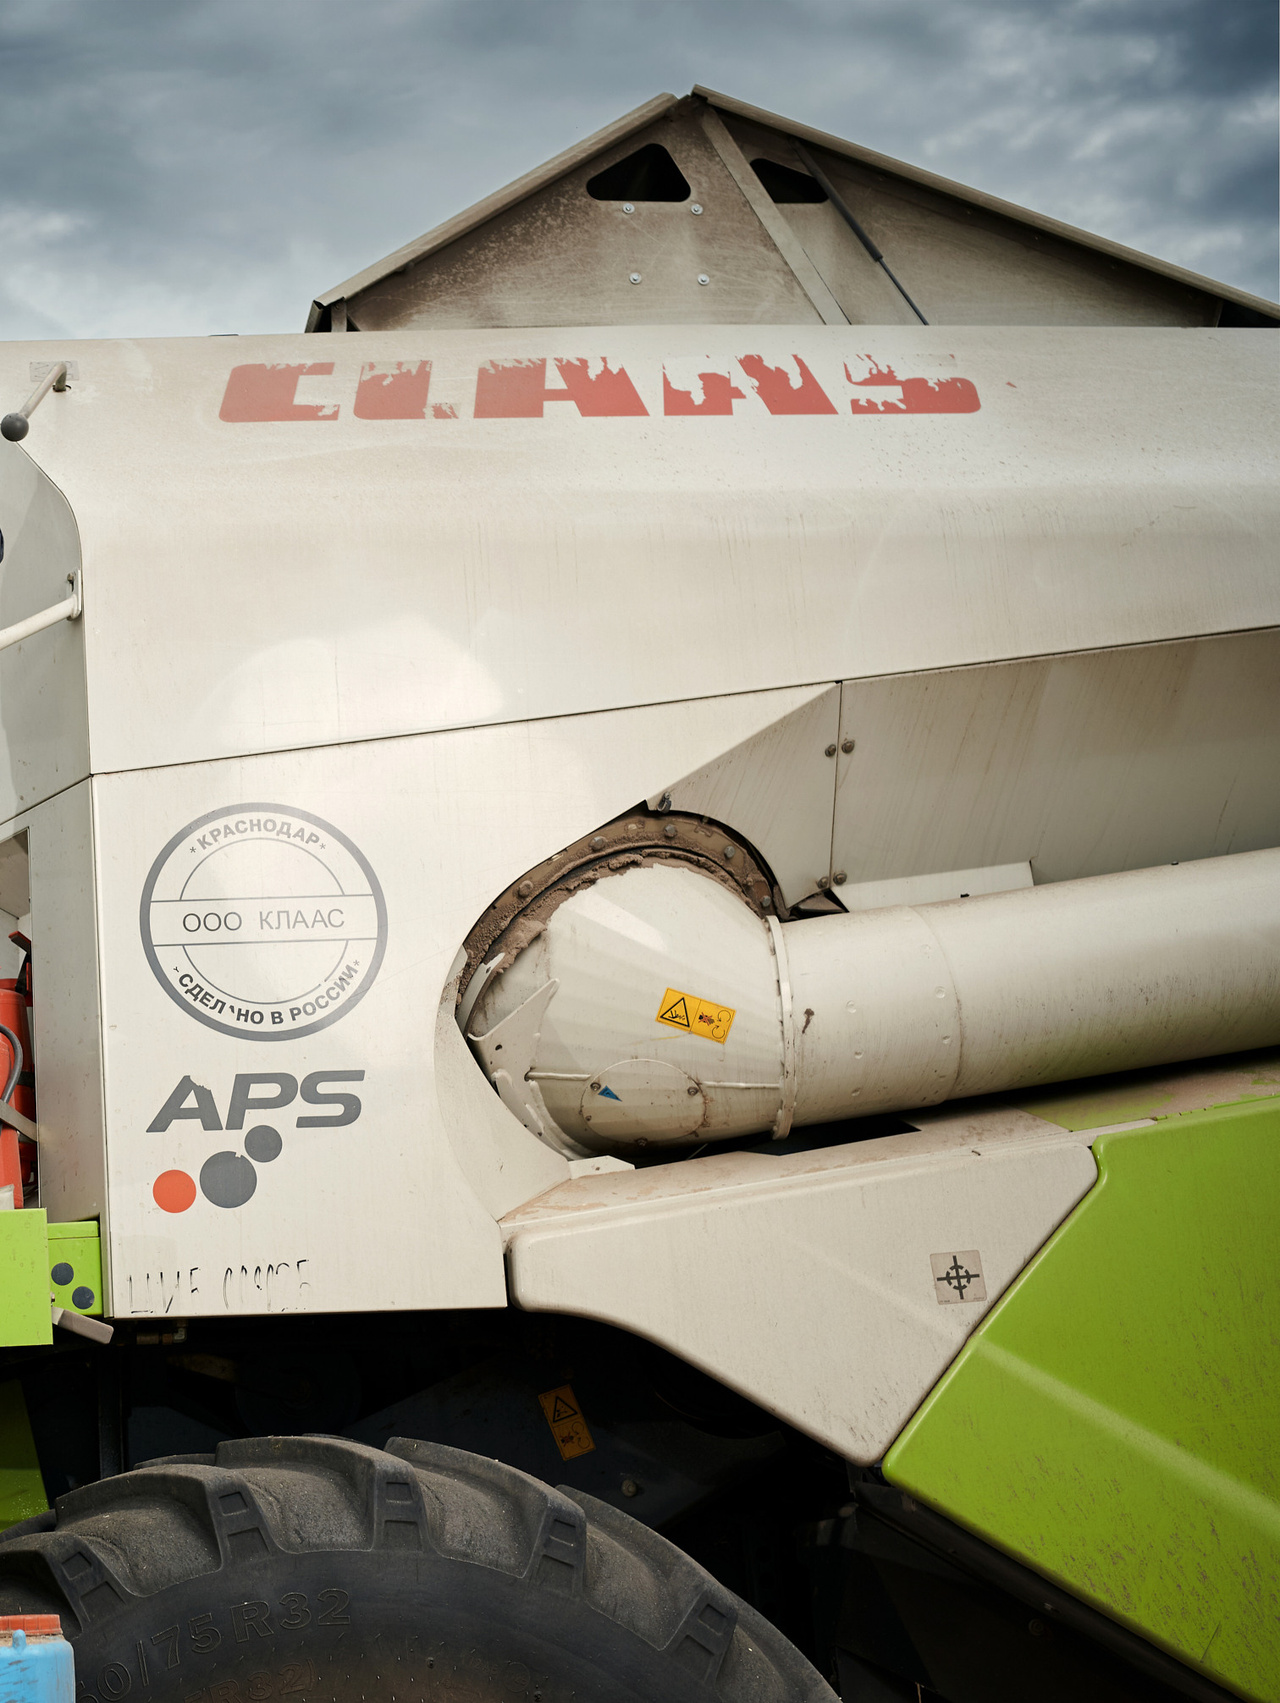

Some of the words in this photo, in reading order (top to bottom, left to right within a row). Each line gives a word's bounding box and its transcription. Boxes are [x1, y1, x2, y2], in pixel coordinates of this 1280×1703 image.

[196, 818, 321, 851] КРАСНОДАР
[182, 911, 243, 933] ООО
[258, 908, 345, 930] КЛААС
[270, 1010, 284, 1025] В
[289, 963, 360, 1022] РОССИИ
[146, 1070, 365, 1133] APS
